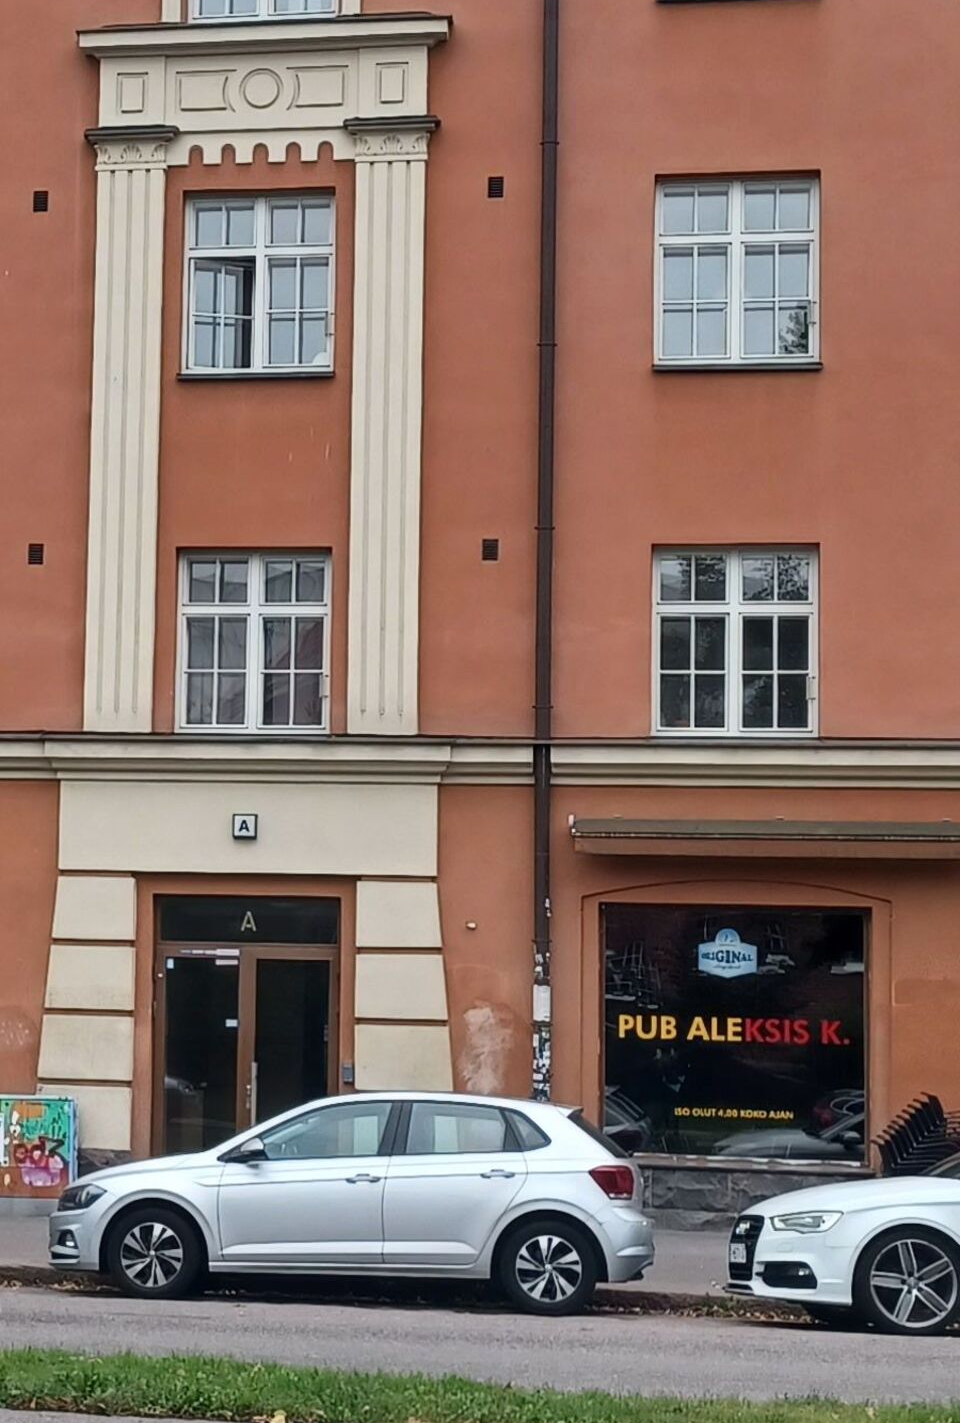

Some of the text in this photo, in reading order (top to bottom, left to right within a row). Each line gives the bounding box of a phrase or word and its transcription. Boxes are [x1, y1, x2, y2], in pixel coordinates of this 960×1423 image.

[239, 819, 250, 832] A
[240, 911, 256, 932] A
[618, 1014, 851, 1045] PUB ALEKSIS K.
[692, 1107, 717, 1117] OLUT
